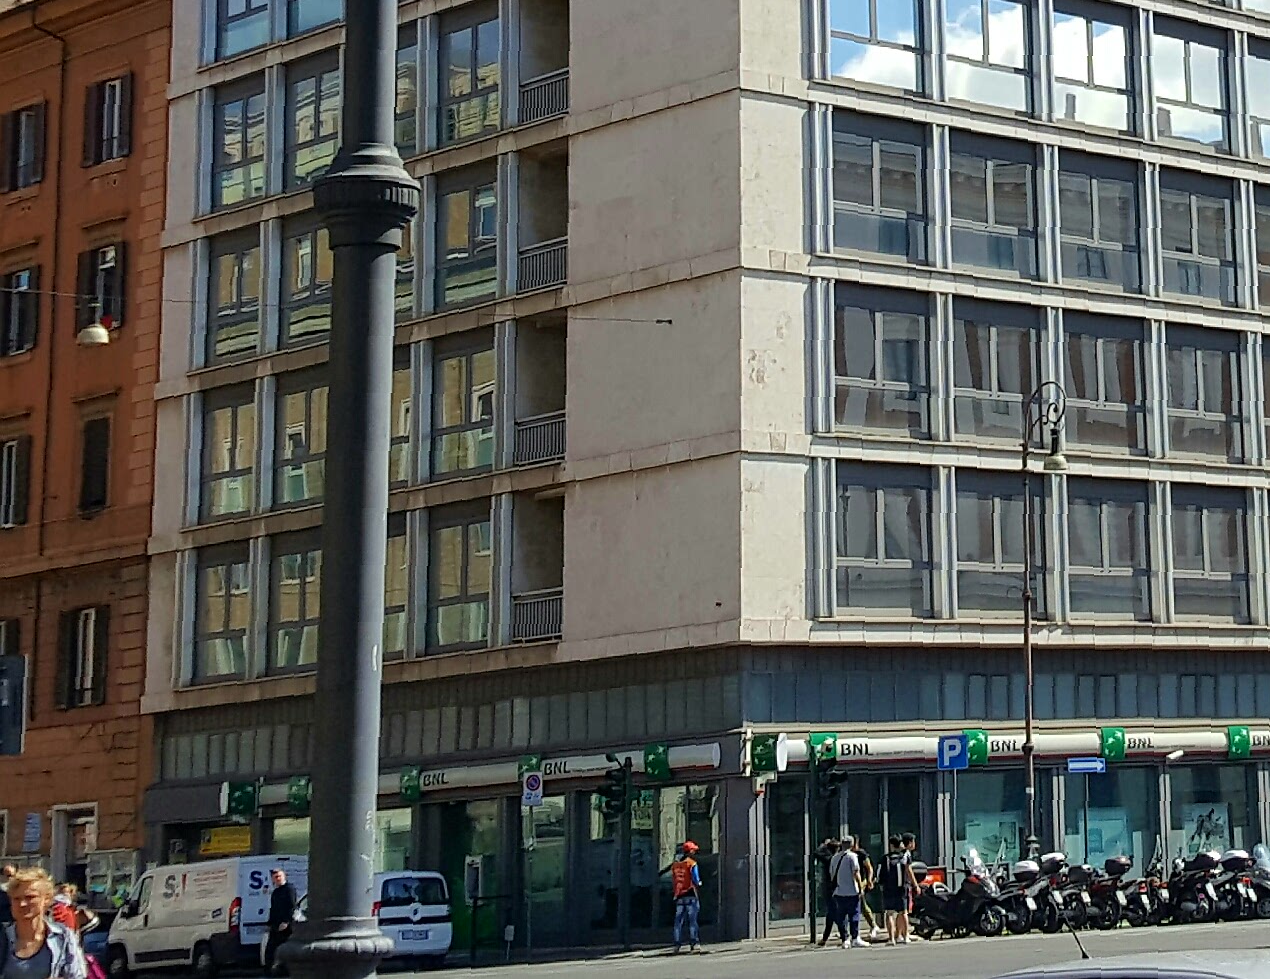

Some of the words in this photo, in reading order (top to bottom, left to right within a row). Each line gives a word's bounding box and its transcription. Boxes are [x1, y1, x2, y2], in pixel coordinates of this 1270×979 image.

[841, 742, 874, 757] BNL
[943, 739, 961, 766] P
[991, 739, 1022, 753] BNL
[544, 760, 571, 776] BNL
[423, 771, 449, 786] BNL
